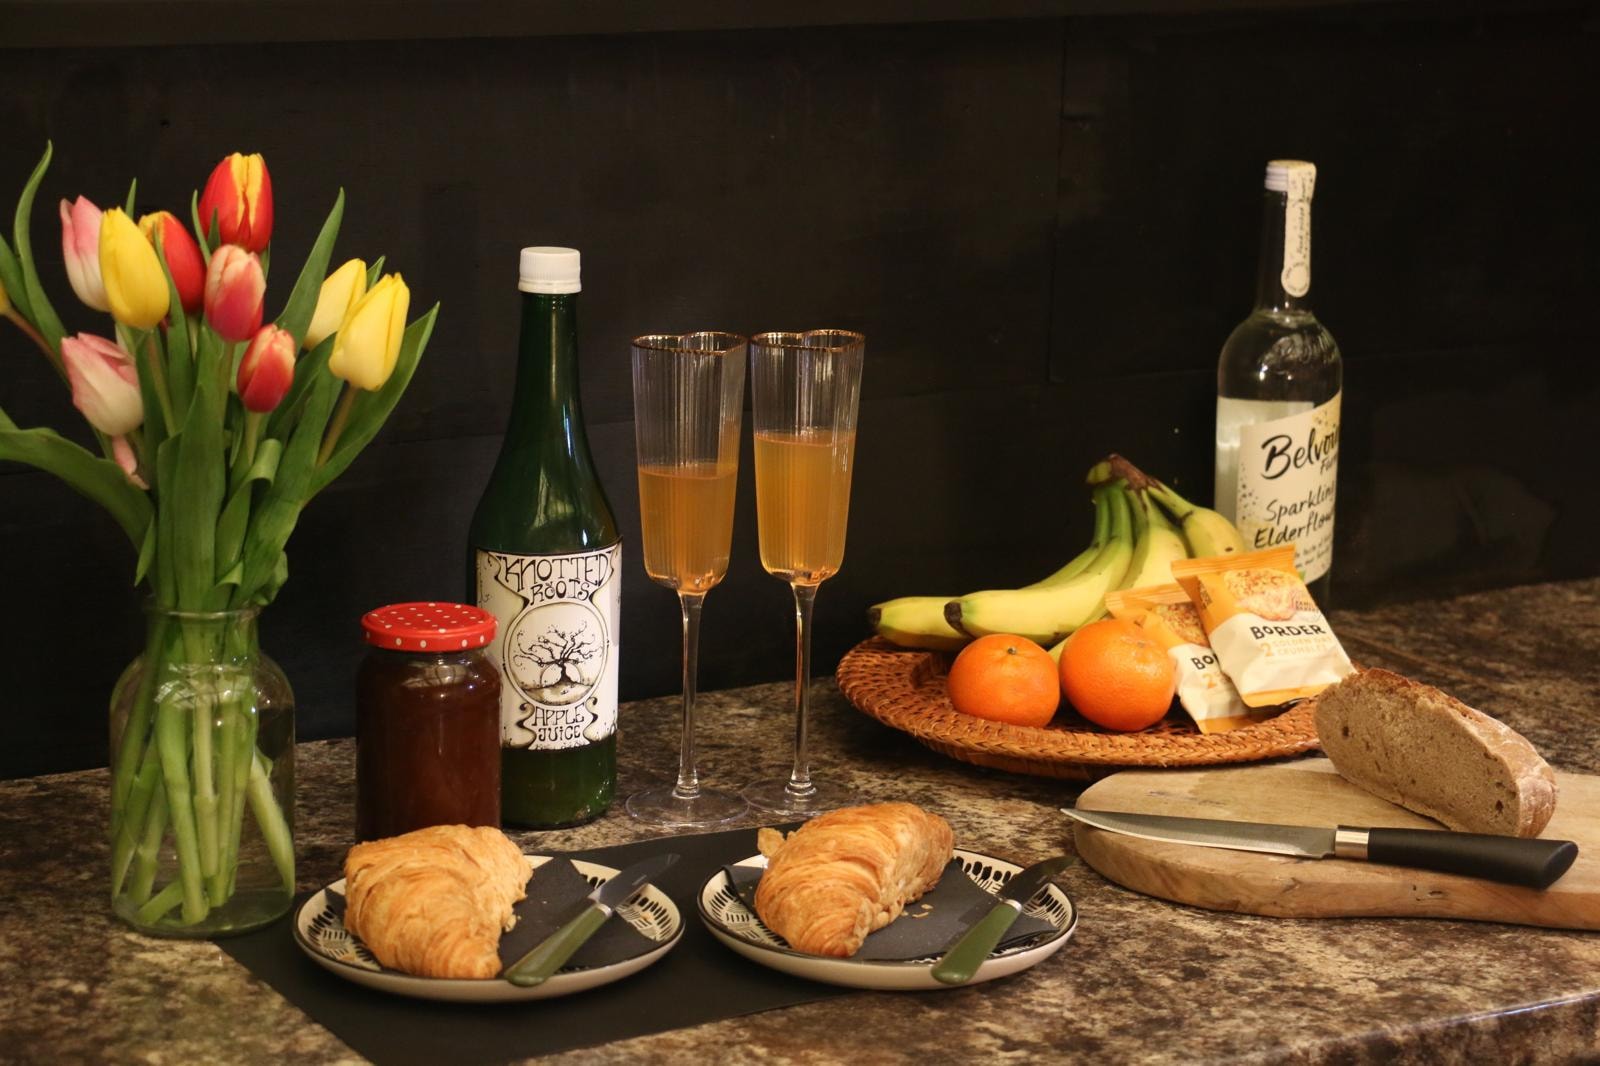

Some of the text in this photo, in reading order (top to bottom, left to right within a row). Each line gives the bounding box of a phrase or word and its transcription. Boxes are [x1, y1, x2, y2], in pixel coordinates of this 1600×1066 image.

[502, 553, 609, 593] KNOTTED
[530, 578, 590, 606] ROOTS
[1250, 624, 1327, 640] BORDER
[1260, 642, 1274, 657] 2
[1202, 672, 1217, 689] 2
[531, 702, 585, 727] APPLE
